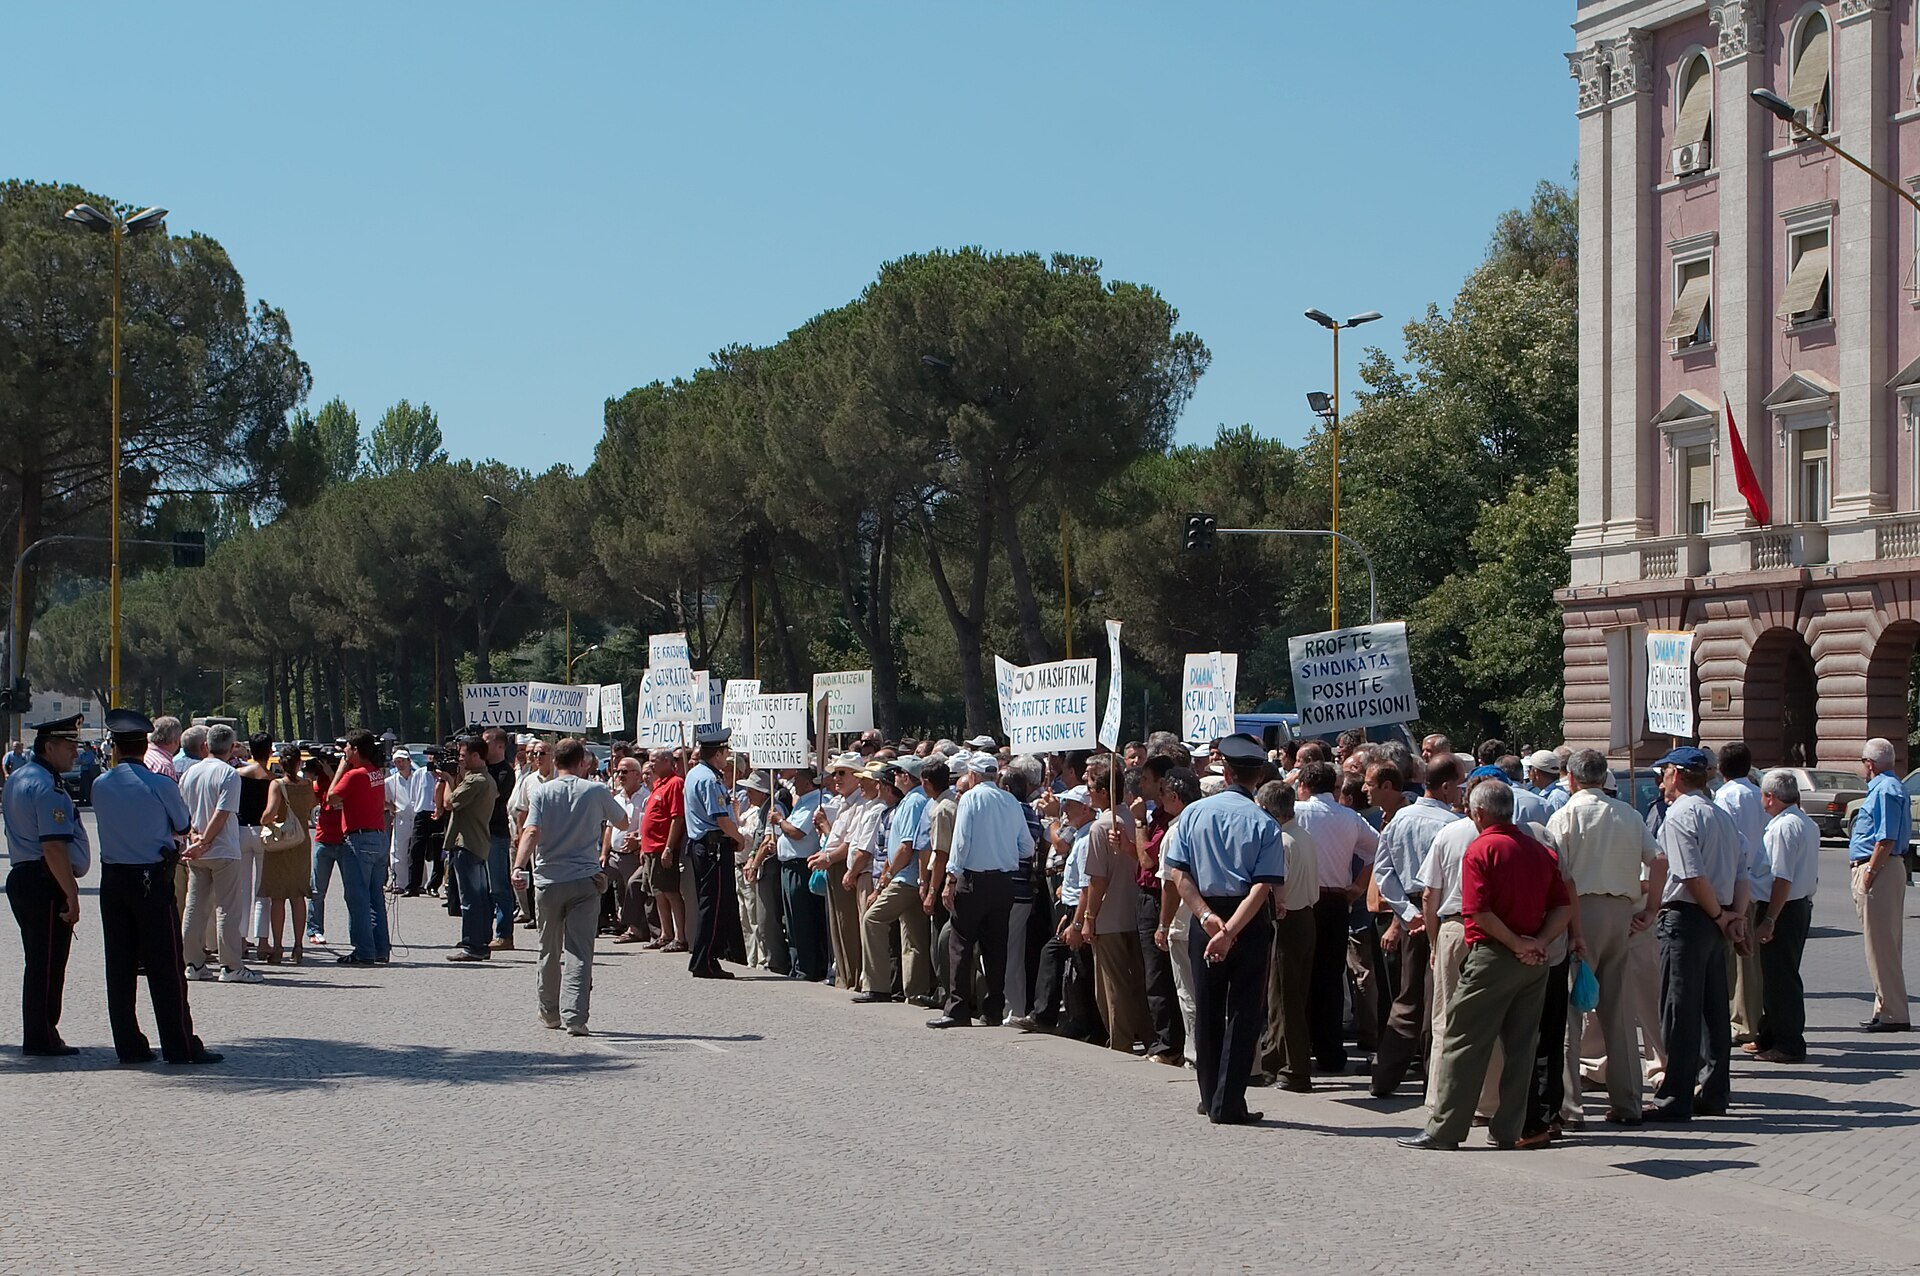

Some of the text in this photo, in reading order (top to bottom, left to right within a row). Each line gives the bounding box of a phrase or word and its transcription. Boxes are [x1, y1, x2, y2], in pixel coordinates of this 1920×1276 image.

[1305, 632, 1372, 658] RROFTE
[1302, 653, 1389, 679] SINDIKATA
[1014, 671, 1034, 694] JO
[1038, 664, 1094, 690] MASHTRIM,
[1312, 676, 1384, 700] POSHTE
[465, 685, 528, 699] MINATOR
[549, 690, 584, 707] PENSION
[469, 710, 521, 725] LAVDI
[1022, 699, 1050, 717] RRITJE
[1054, 696, 1088, 714] REALE
[1302, 694, 1410, 725] KORRUPSIONI
[761, 715, 776, 730] JO
[1012, 728, 1022, 744] TE
[1026, 721, 1087, 743] PENSIONEVE
